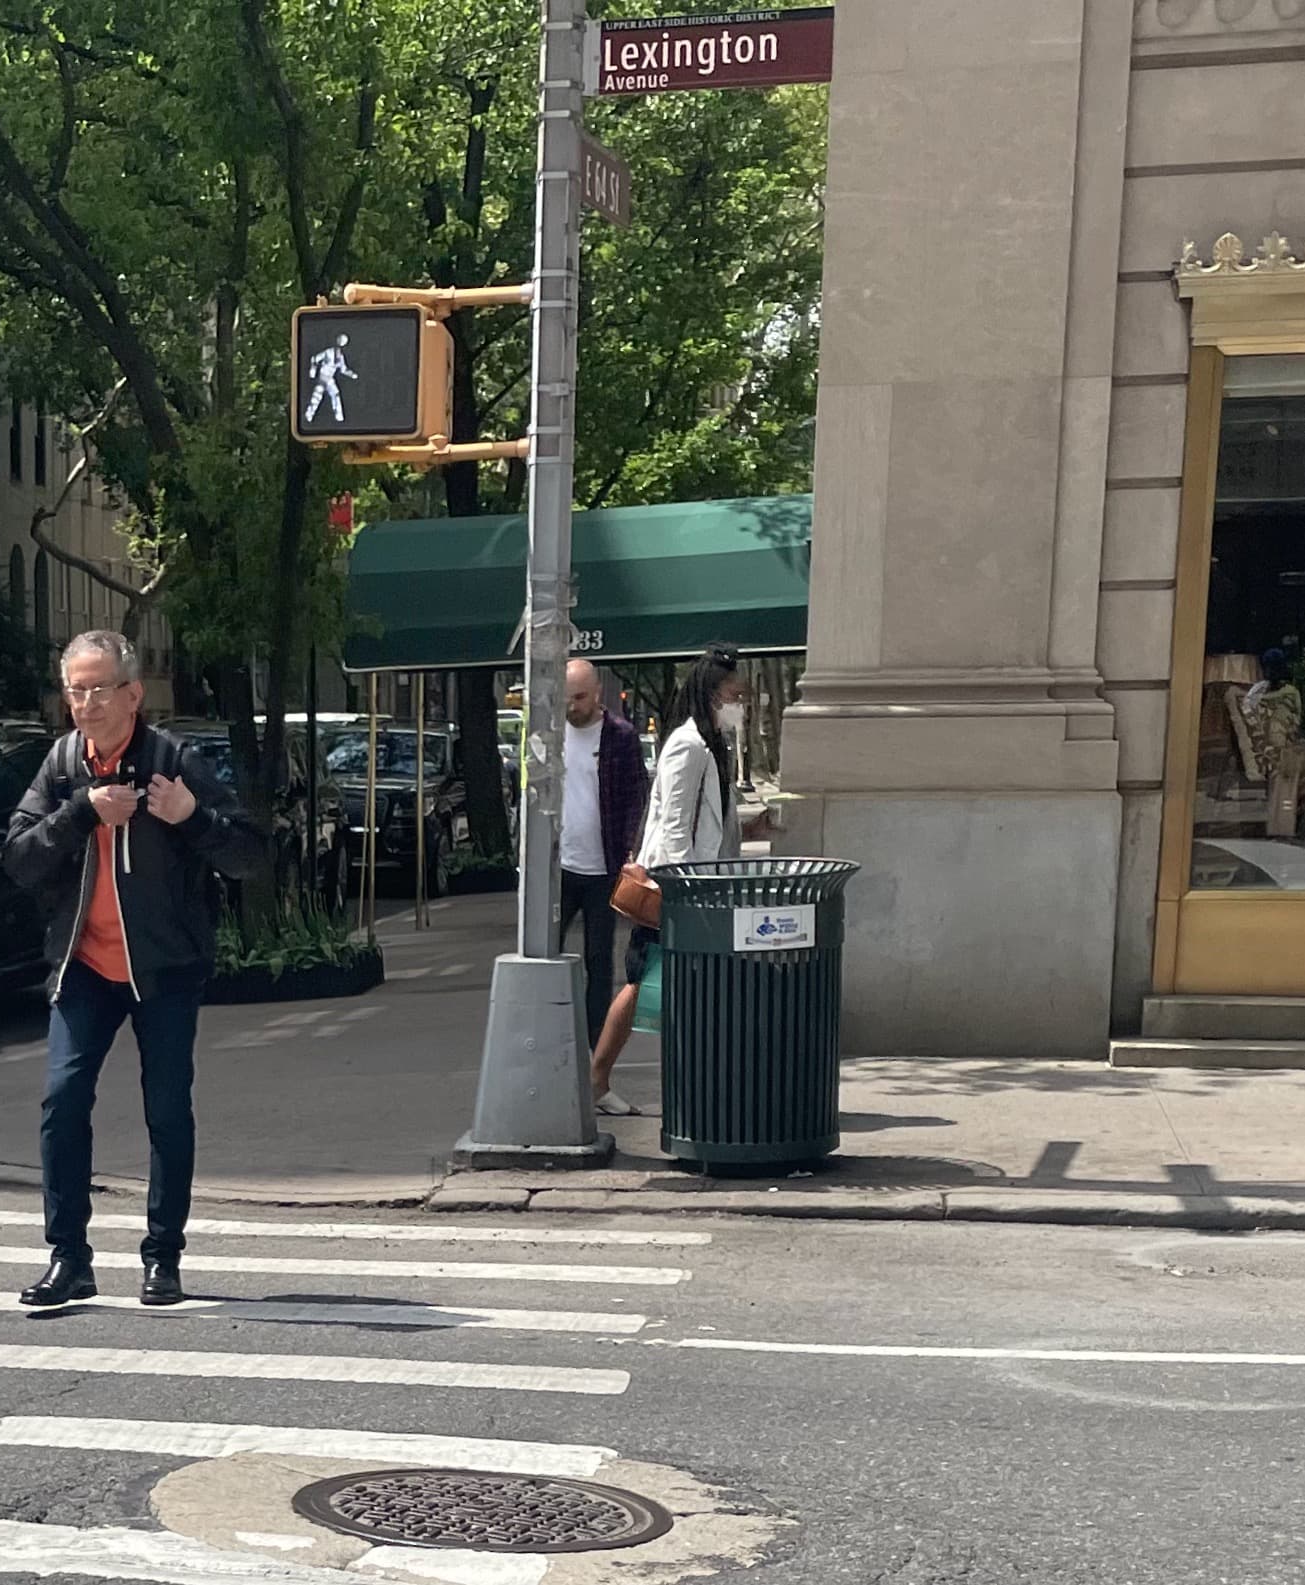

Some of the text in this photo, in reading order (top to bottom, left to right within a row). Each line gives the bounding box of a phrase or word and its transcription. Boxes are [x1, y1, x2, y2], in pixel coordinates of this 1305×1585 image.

[605, 11, 782, 31] UPPER EAST SIDE HISTORIC DISTRICT
[603, 30, 778, 75] Lexington
[604, 73, 669, 91] Avenue
[569, 630, 604, 651] 33
